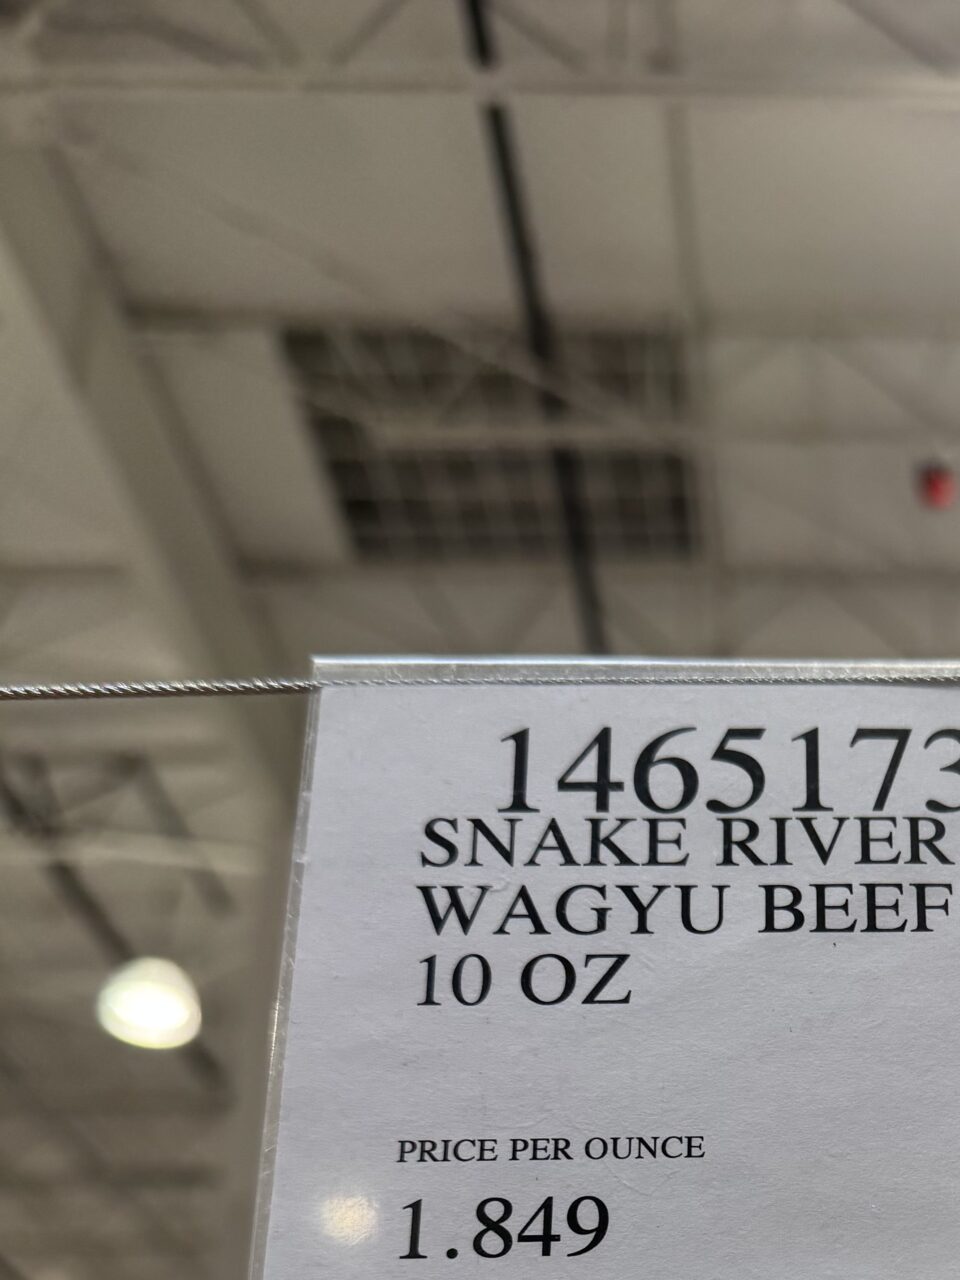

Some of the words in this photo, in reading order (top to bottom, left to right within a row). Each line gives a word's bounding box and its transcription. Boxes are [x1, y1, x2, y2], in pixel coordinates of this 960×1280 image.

[420, 817, 690, 868] SNAKE
[715, 816, 956, 867] RIVER
[415, 884, 731, 936] WAGYU
[757, 882, 953, 934] BEEF
[416, 953, 492, 1007] 10
[519, 953, 632, 1006] OZ
[395, 1138, 499, 1163] PRICE
[508, 1137, 574, 1162] PER
[584, 1135, 706, 1161] OUNCE
[398, 1195, 610, 1260] 1.849
